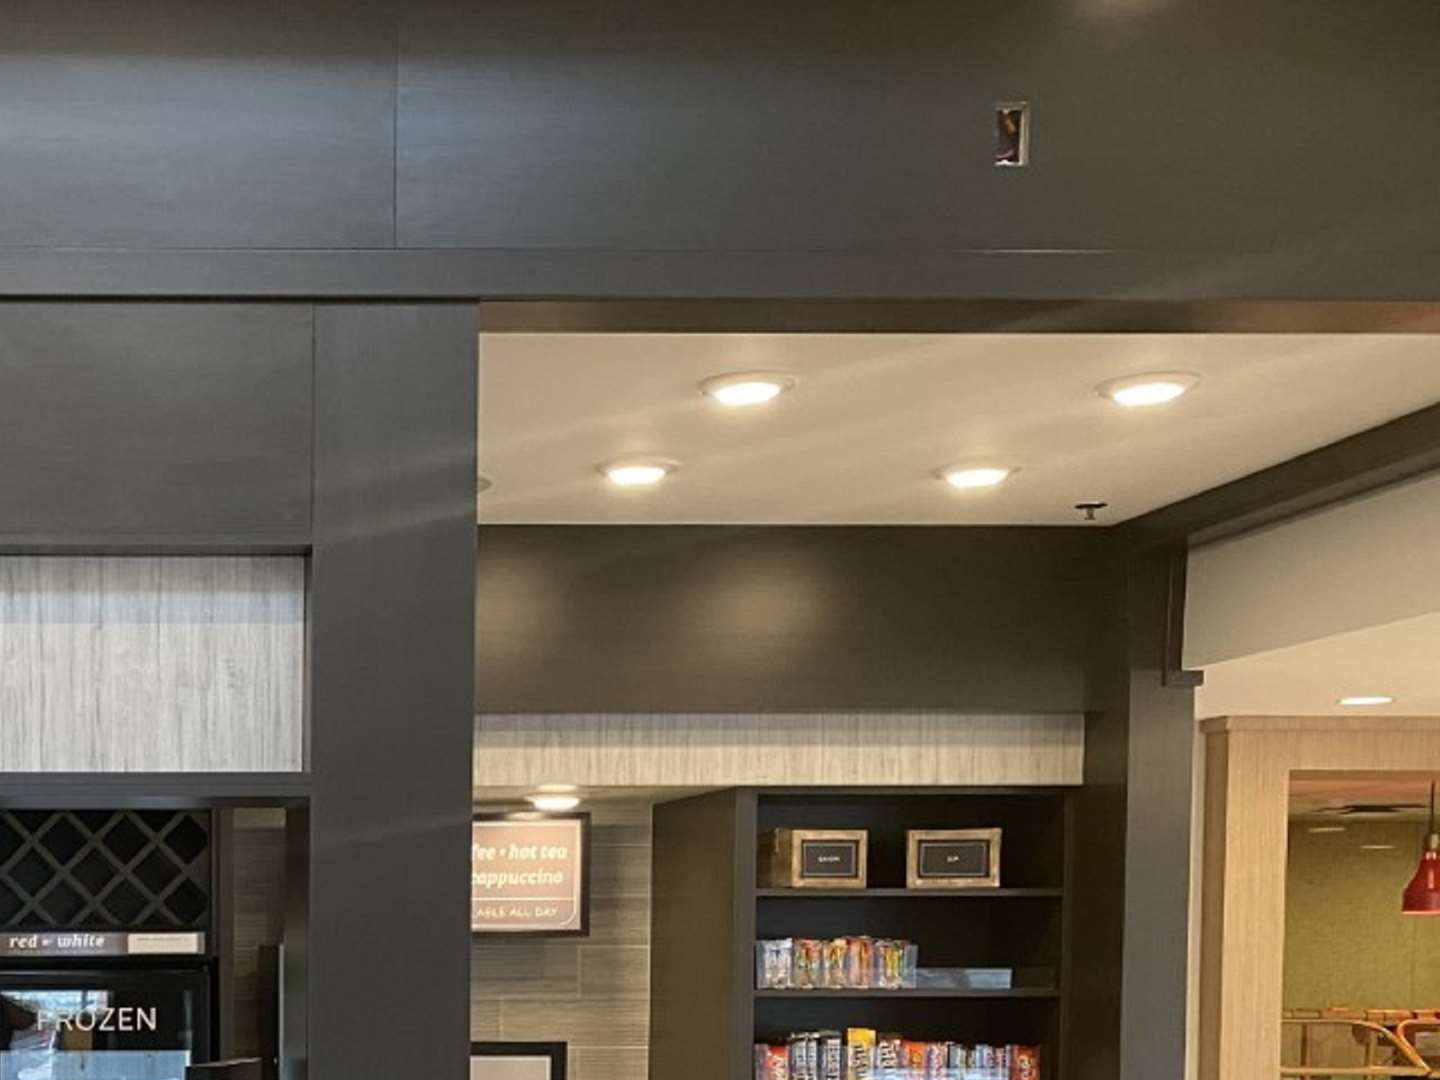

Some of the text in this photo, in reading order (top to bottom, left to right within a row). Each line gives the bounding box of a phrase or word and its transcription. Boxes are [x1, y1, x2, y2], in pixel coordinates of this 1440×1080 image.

[509, 843, 537, 860] hot
[541, 845, 568, 860] tea
[10, 934, 105, 949] red white
[36, 1007, 157, 1031] FROZEN
